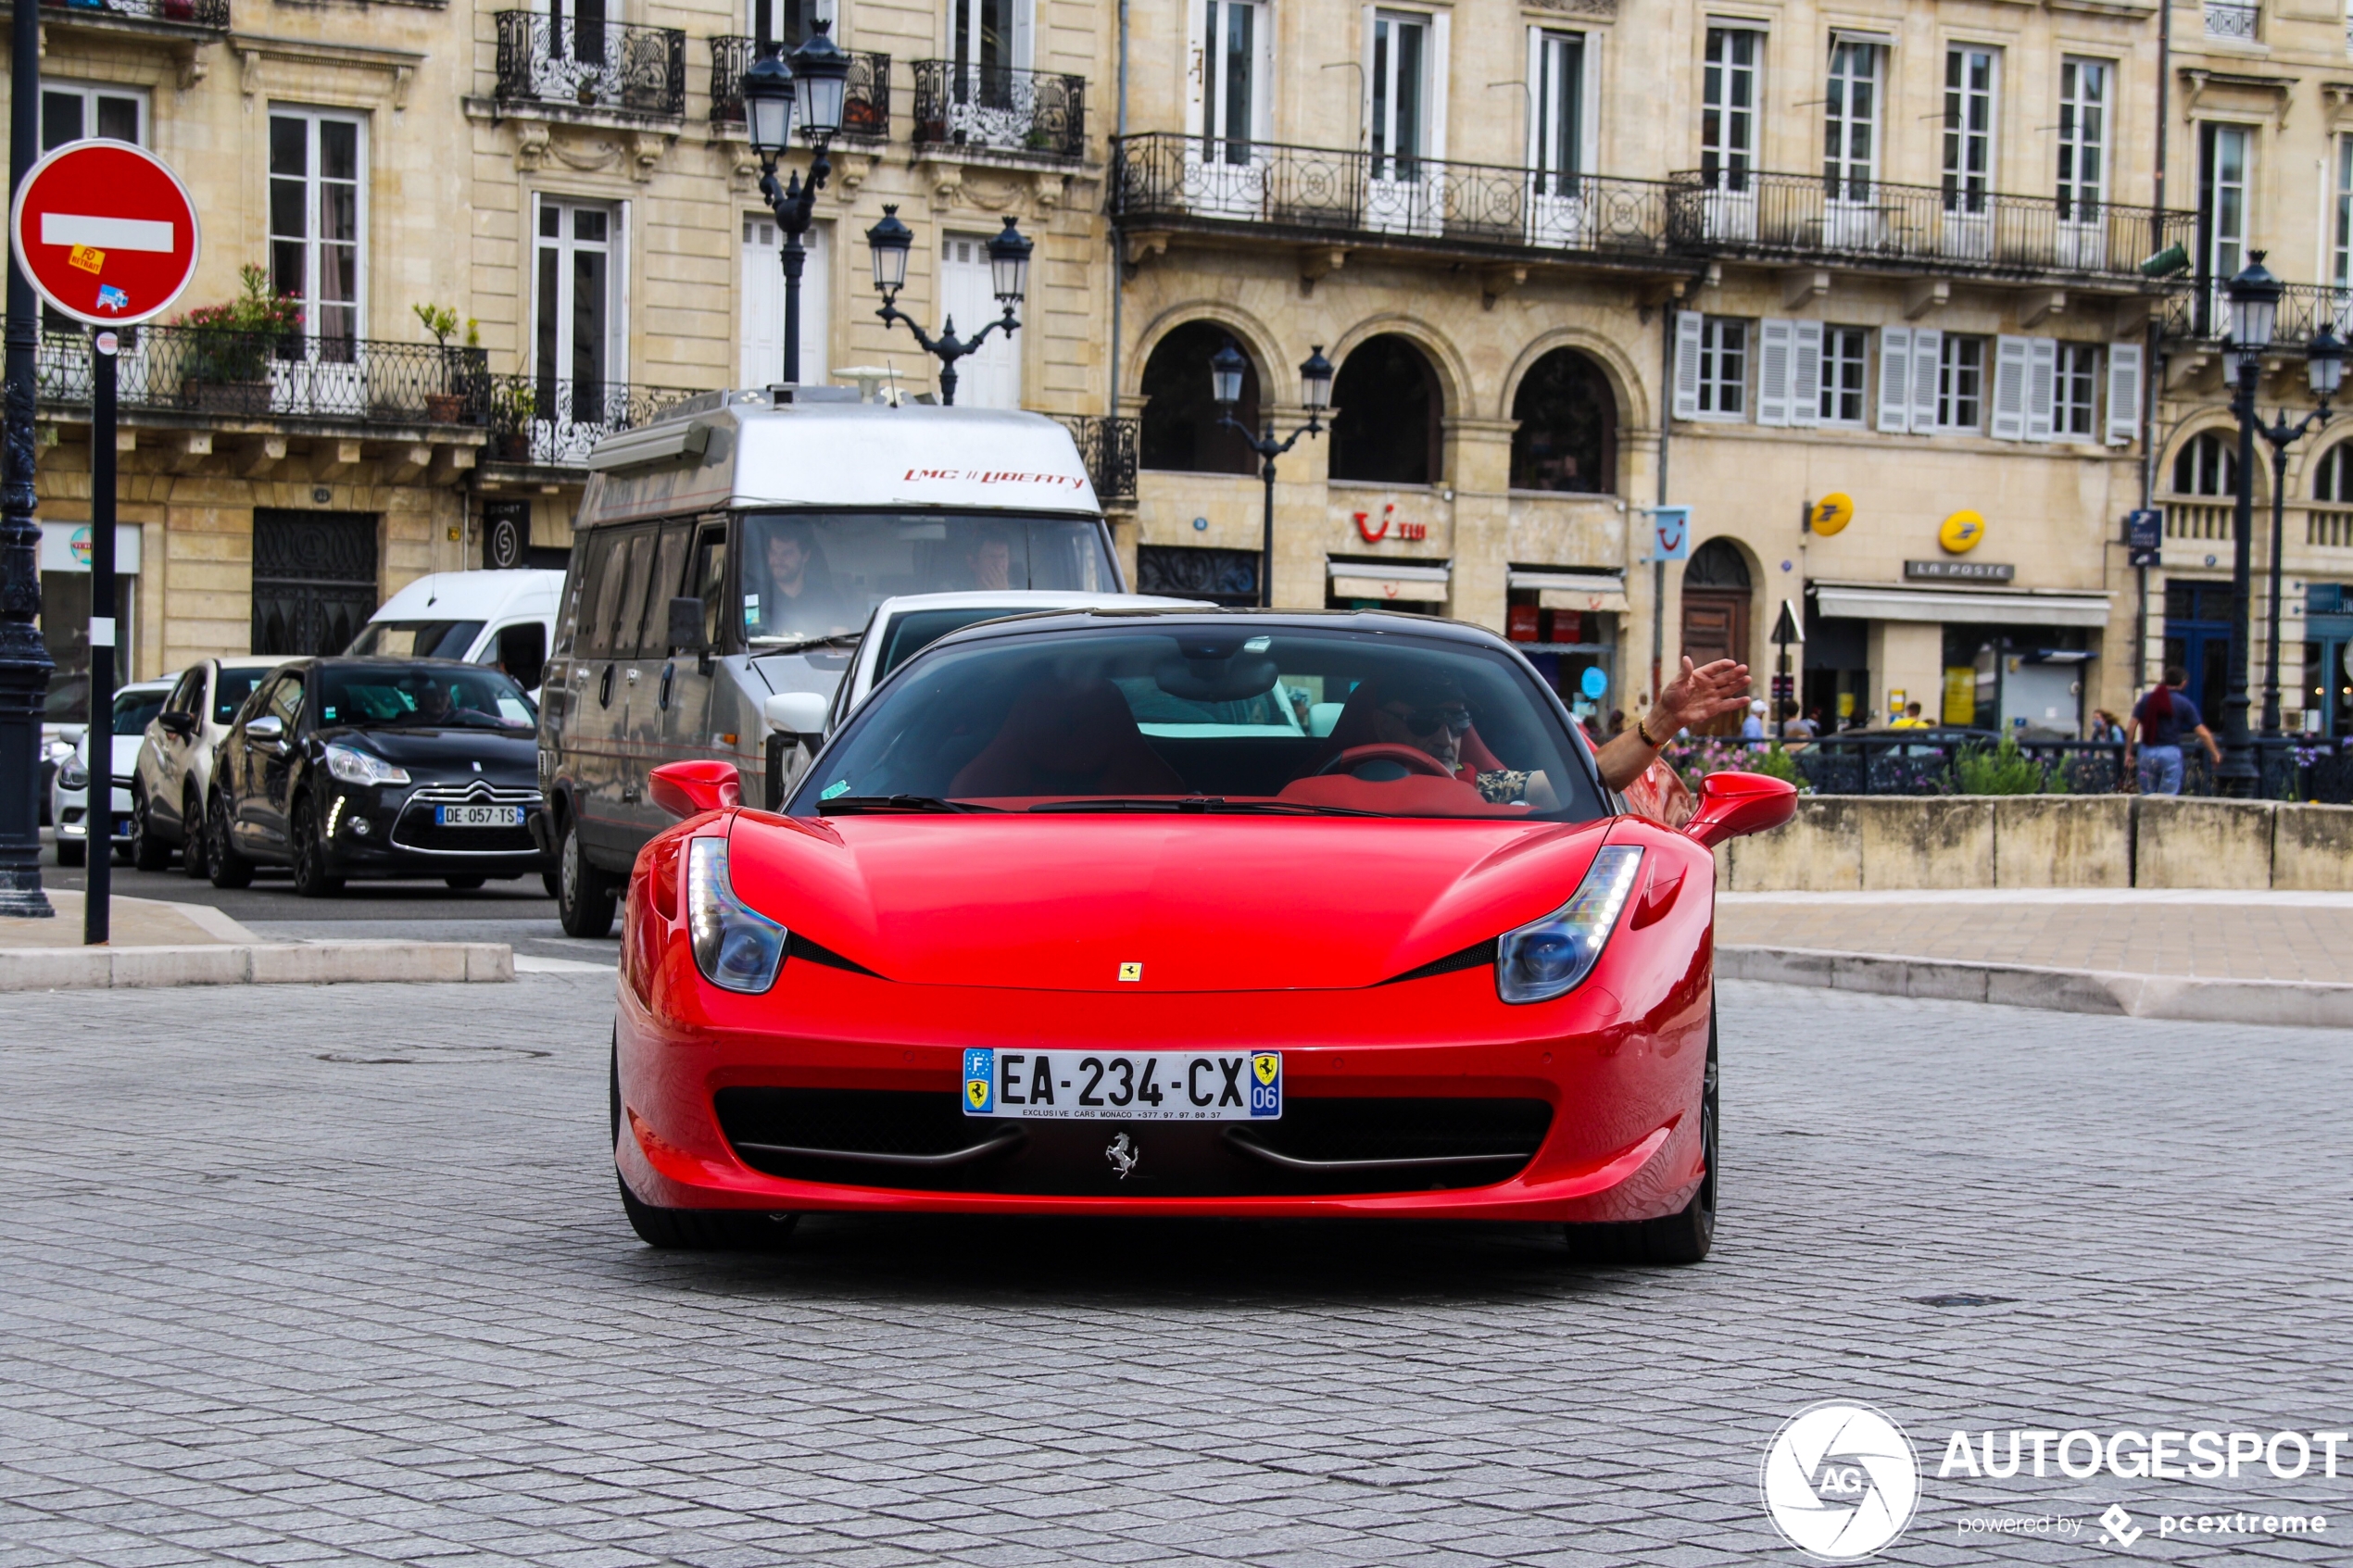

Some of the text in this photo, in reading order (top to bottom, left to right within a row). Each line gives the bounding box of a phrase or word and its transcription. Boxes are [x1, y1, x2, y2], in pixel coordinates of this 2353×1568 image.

[82, 247, 95, 260] FO
[71, 256, 101, 272] RETRAIT
[903, 469, 959, 482] LMC
[980, 470, 1084, 490] LIBERTY
[1398, 522, 1427, 540] TUI
[1917, 562, 2008, 577] LA POSTE
[974, 1057, 984, 1072] F
[1000, 1054, 1244, 1108] EA-234-CX
[1252, 1086, 1277, 1109] 06
[1023, 1109, 1070, 1117] EXCLUSIVE
